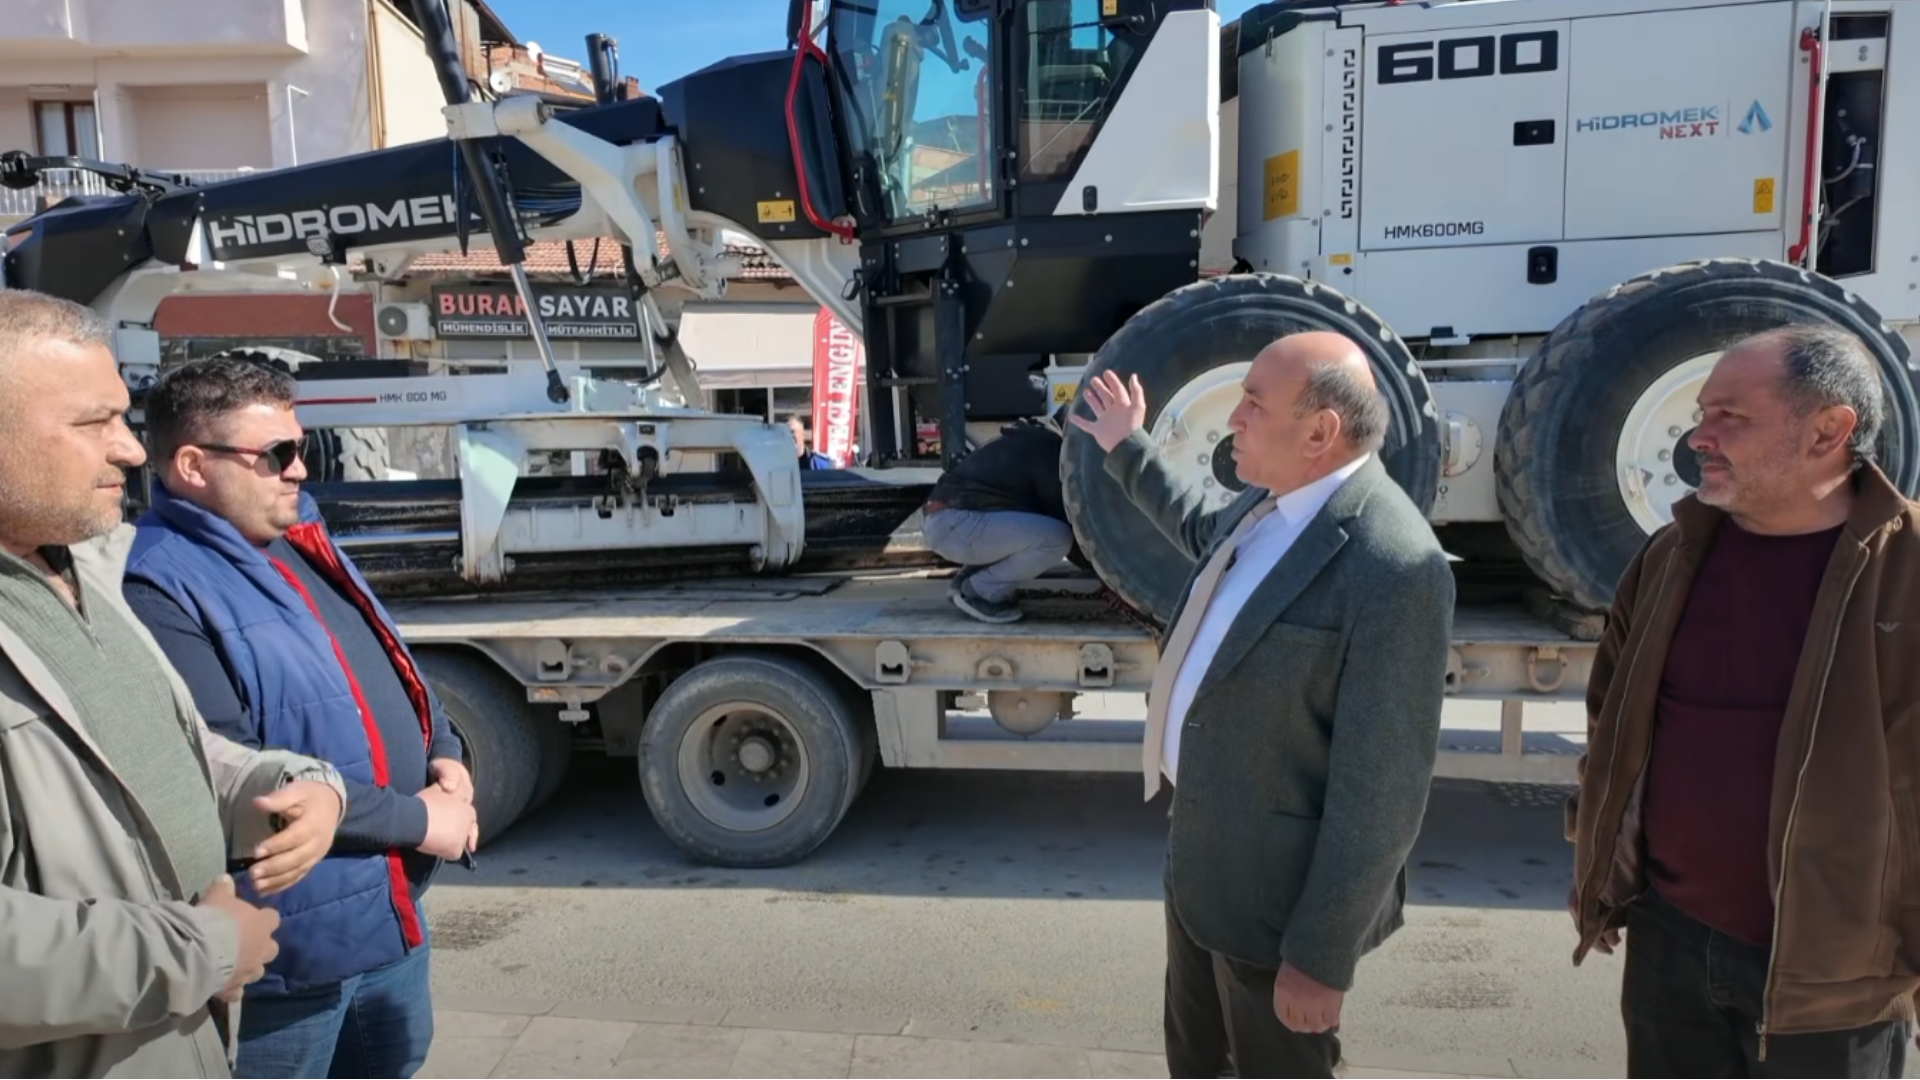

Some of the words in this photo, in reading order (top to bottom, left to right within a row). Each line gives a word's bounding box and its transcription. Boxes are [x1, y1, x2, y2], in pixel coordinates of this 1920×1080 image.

[1377, 30, 1559, 85] 600
[1659, 121, 1719, 140] NEXT
[1384, 221, 1485, 240] HMK600MG
[539, 295, 630, 317] SAYAR
[442, 321, 525, 334] MÜHENDİSLİK
[547, 323, 633, 336] MÜTEAHHİTLİK
[379, 392, 403, 404] HMK
[406, 391, 427, 402] 600
[430, 390, 447, 402] MG
